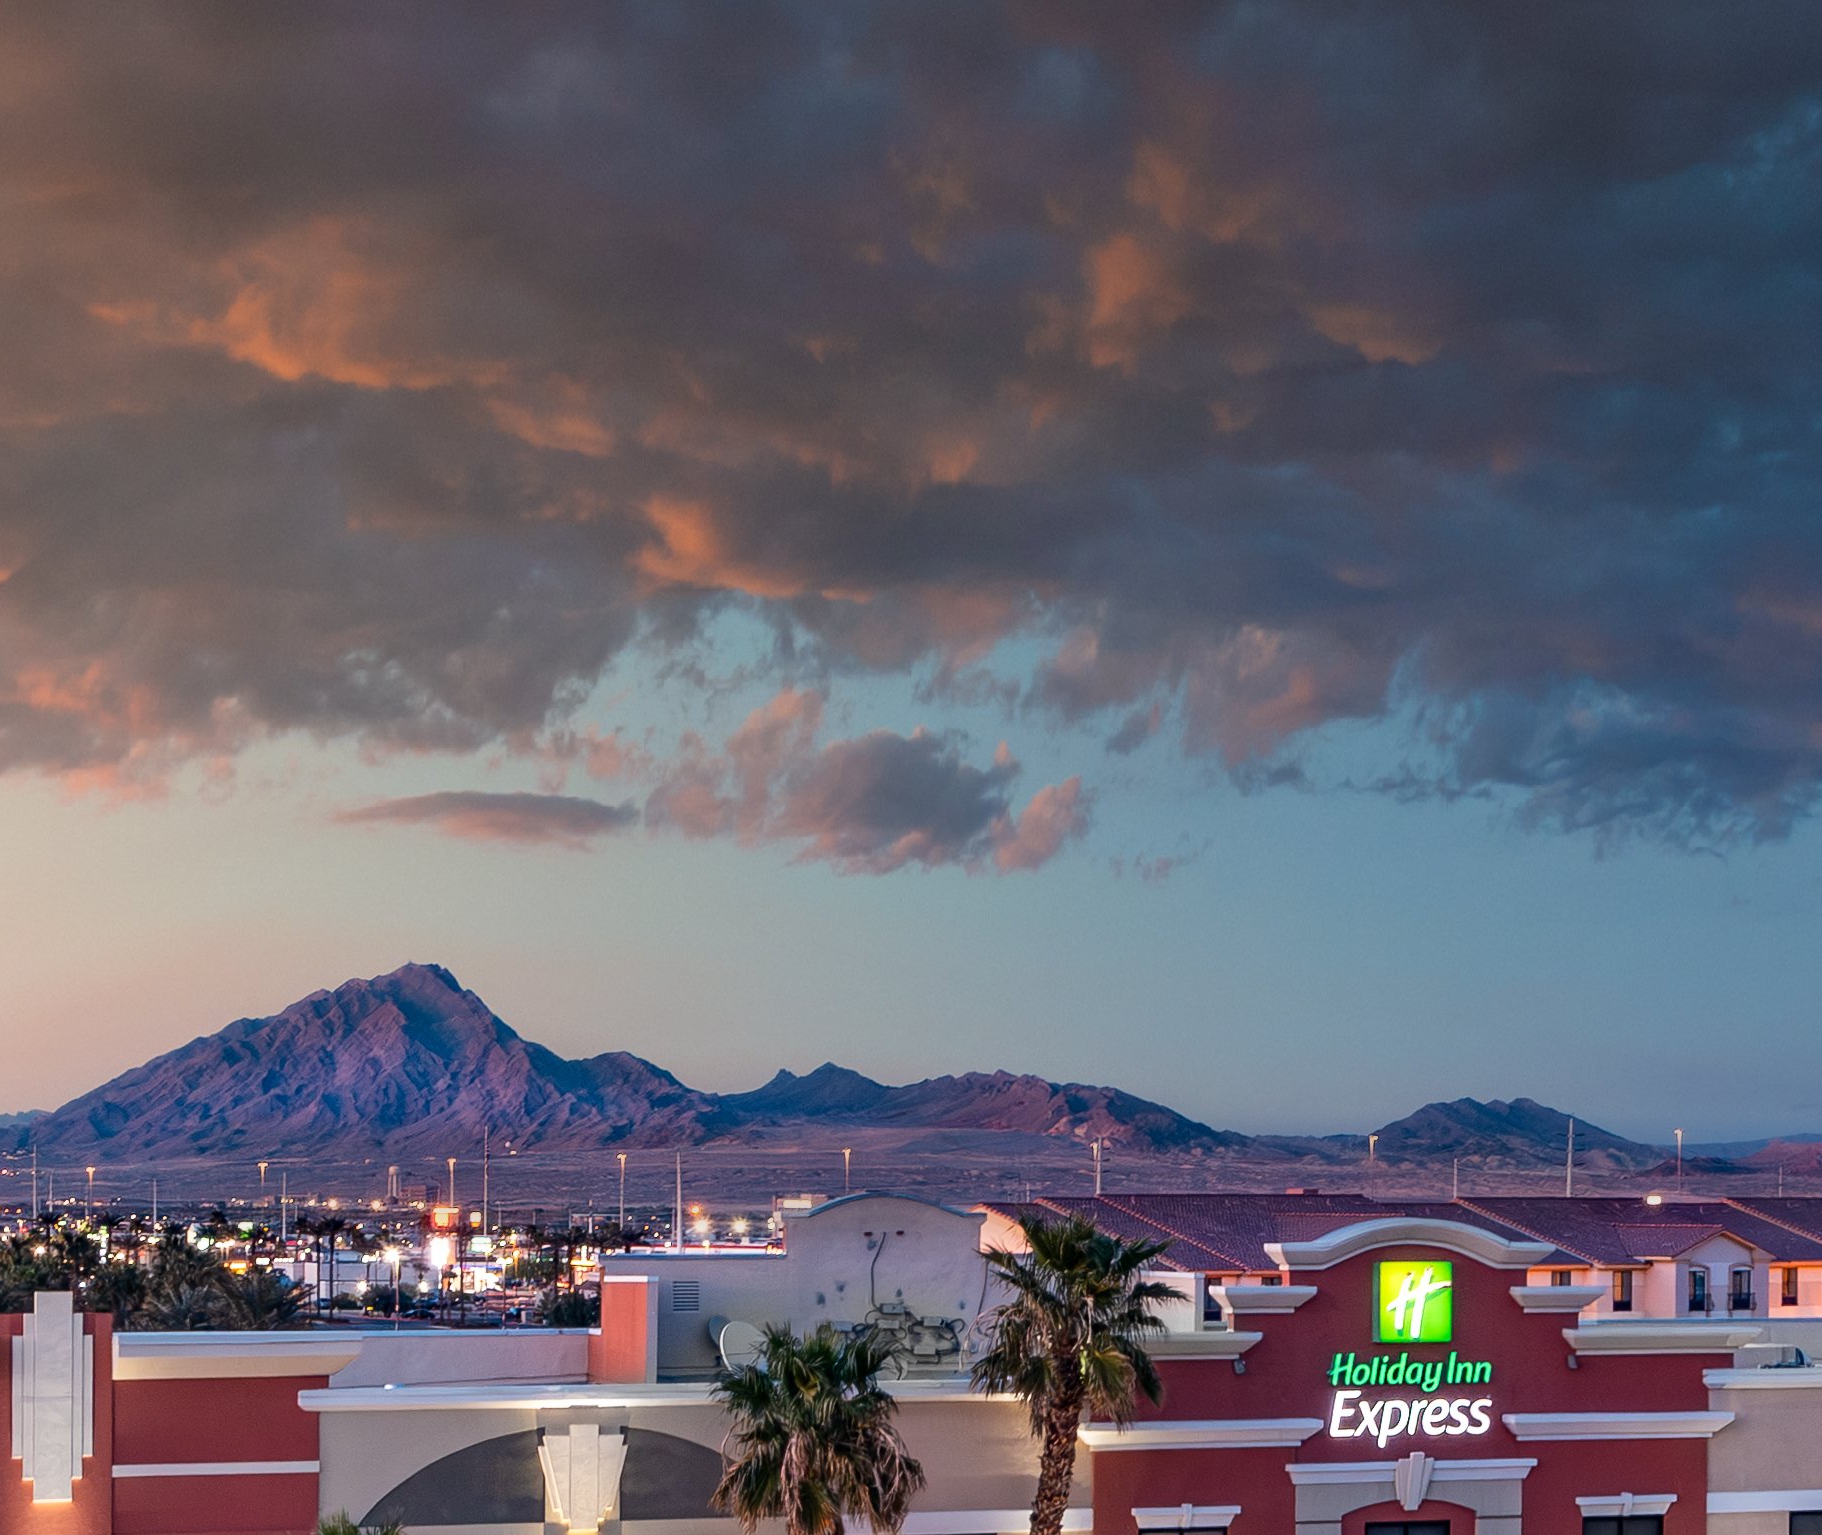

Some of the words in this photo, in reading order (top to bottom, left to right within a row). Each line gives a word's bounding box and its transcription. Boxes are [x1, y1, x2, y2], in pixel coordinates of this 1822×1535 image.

[1328, 1352, 1442, 1393] Holiday
[1446, 1352, 1492, 1385] Inn
[1329, 1389, 1493, 1449] Express
